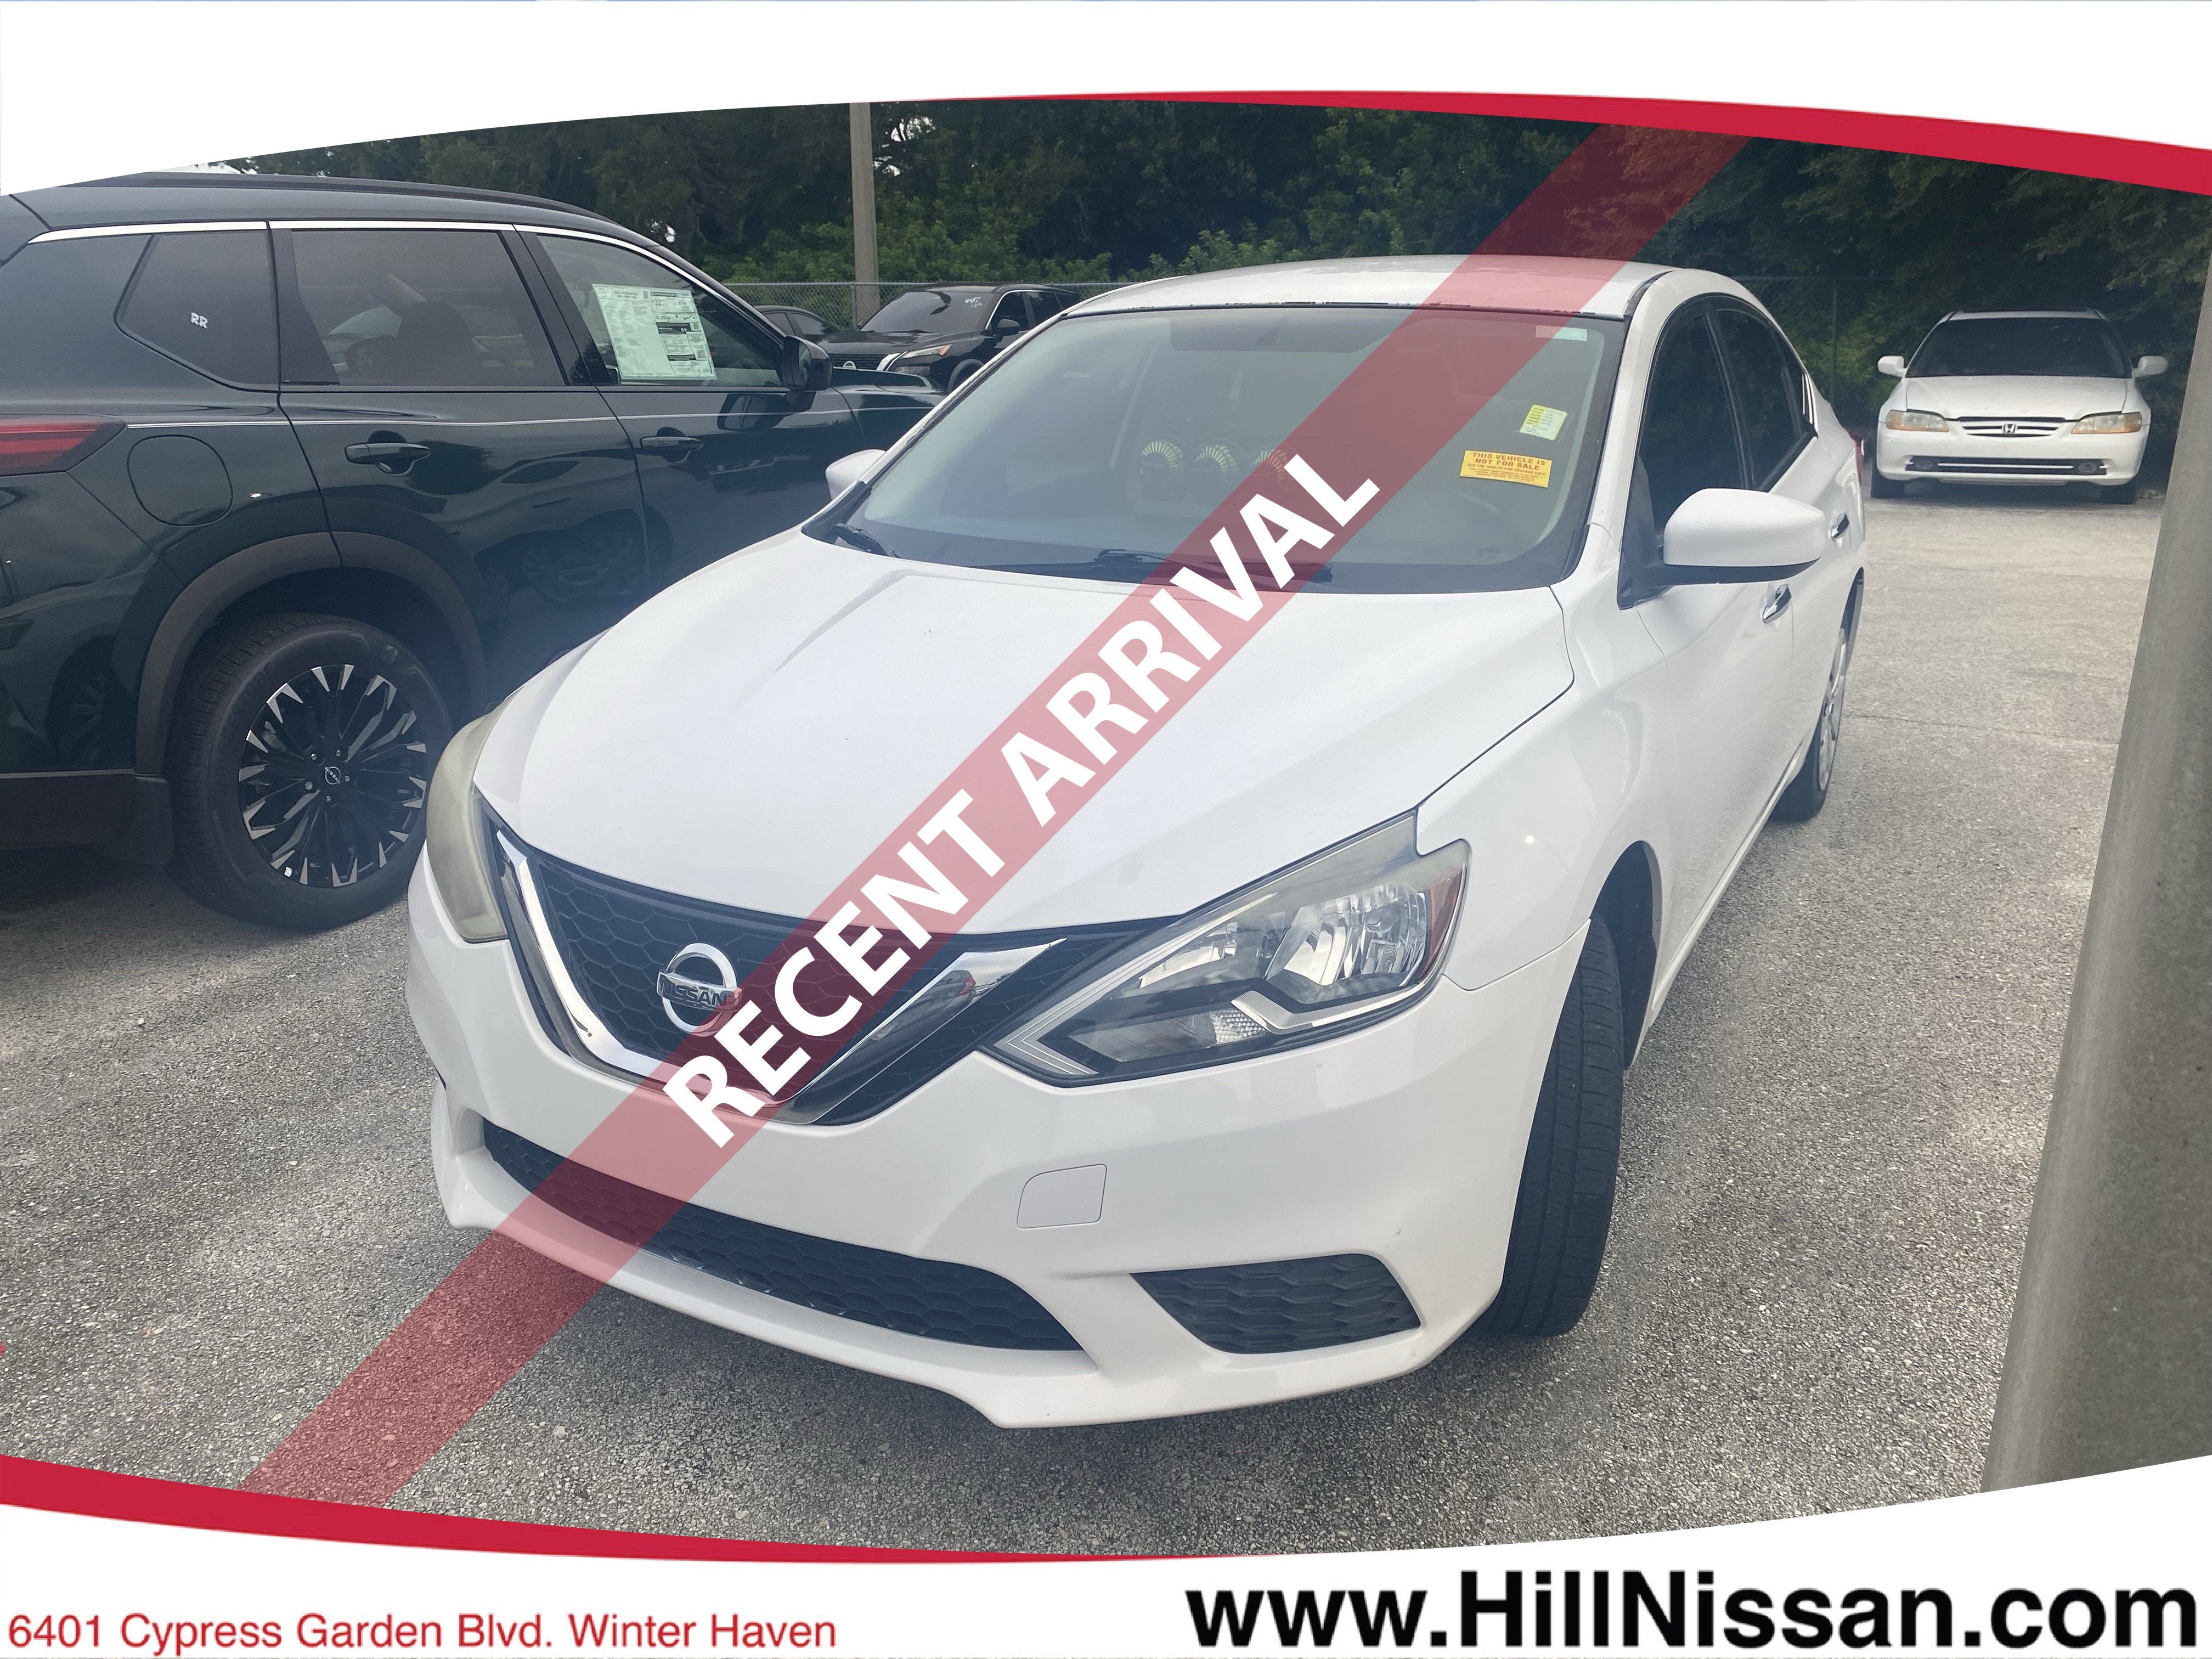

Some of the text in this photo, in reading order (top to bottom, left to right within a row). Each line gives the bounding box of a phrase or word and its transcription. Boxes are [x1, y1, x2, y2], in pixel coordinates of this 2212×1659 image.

[190, 312, 208, 329] RR
[1496, 454, 1533, 464] VEHICLE
[660, 979, 729, 1008] NISSAN
